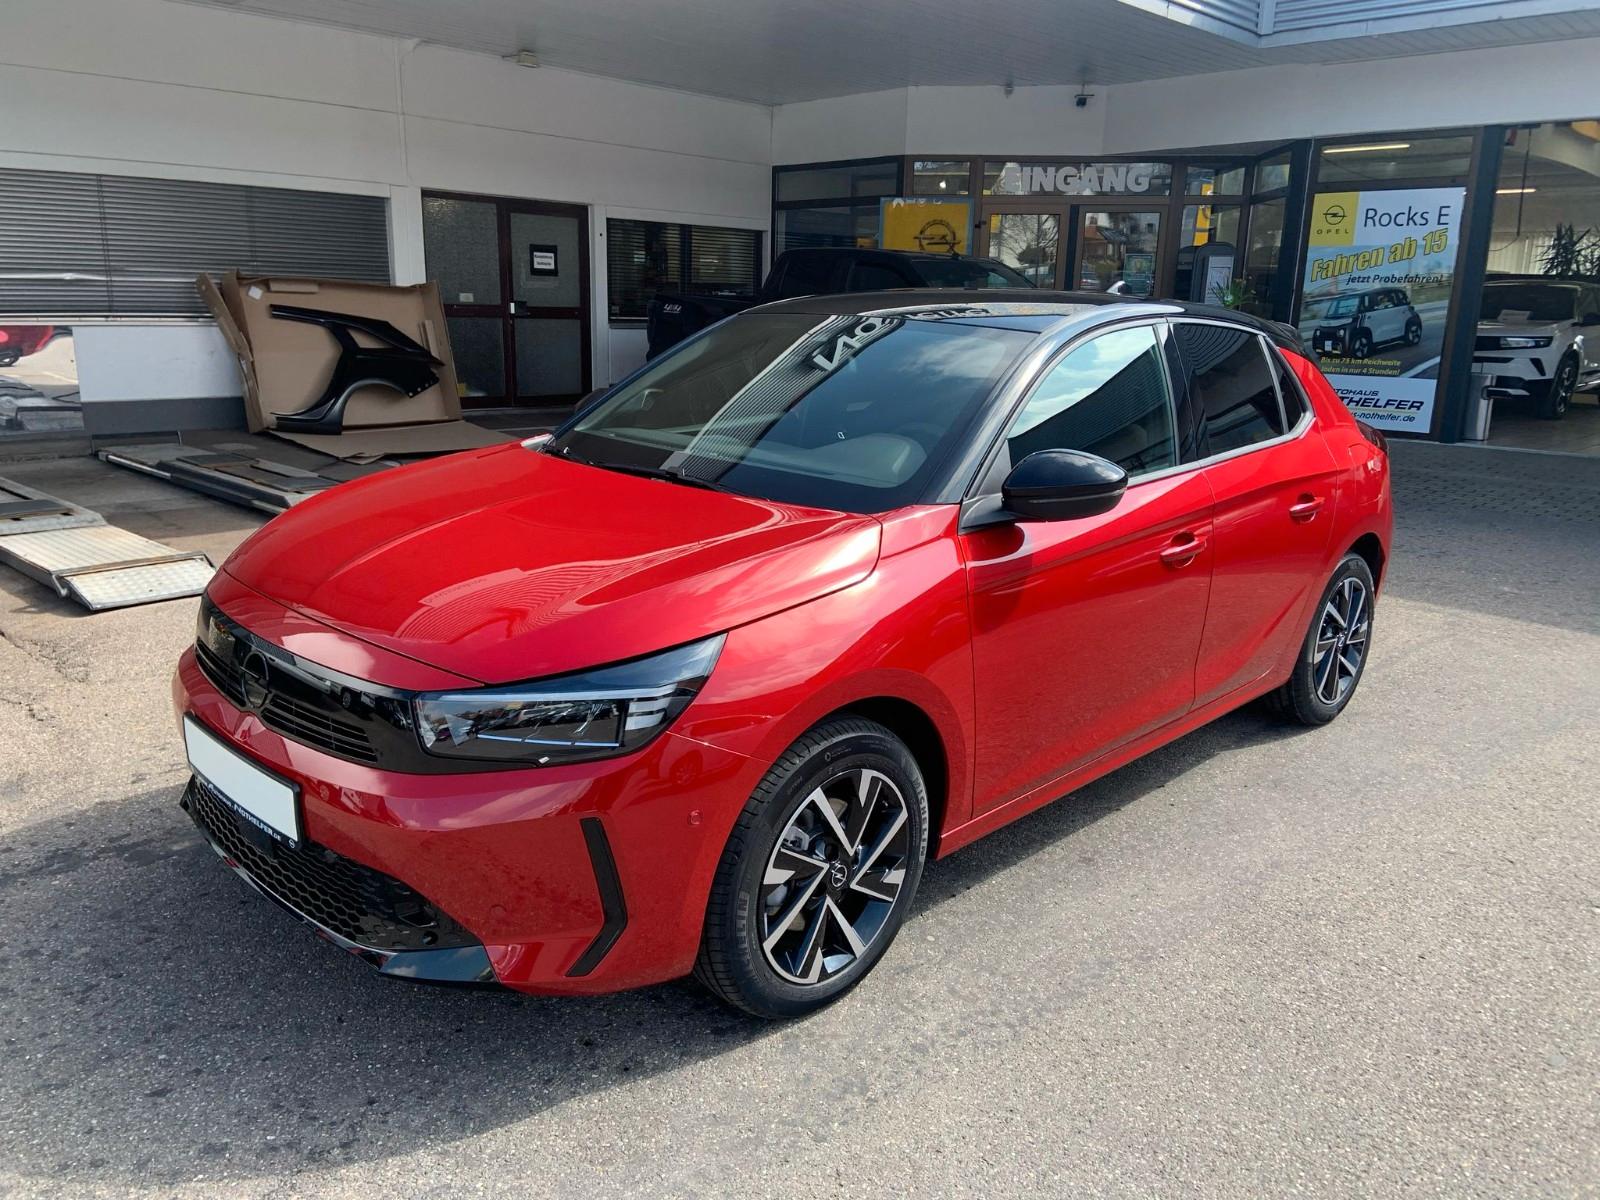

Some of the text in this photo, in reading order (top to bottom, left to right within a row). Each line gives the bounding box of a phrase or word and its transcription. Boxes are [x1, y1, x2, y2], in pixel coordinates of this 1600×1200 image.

[1004, 165, 1151, 193] EINGANG
[1364, 205, 1452, 228] Rocks E
[1310, 227, 1449, 282] Fahren ab 15
[1346, 273, 1443, 286] jetzt Probefahren!
[1351, 357, 1362, 365] km
[1362, 358, 1401, 367] Reichweite
[1333, 388, 1379, 397] TOHAUS
[1339, 396, 1424, 411] THELFER
[1352, 411, 1416, 423] s-nothelfer.de
